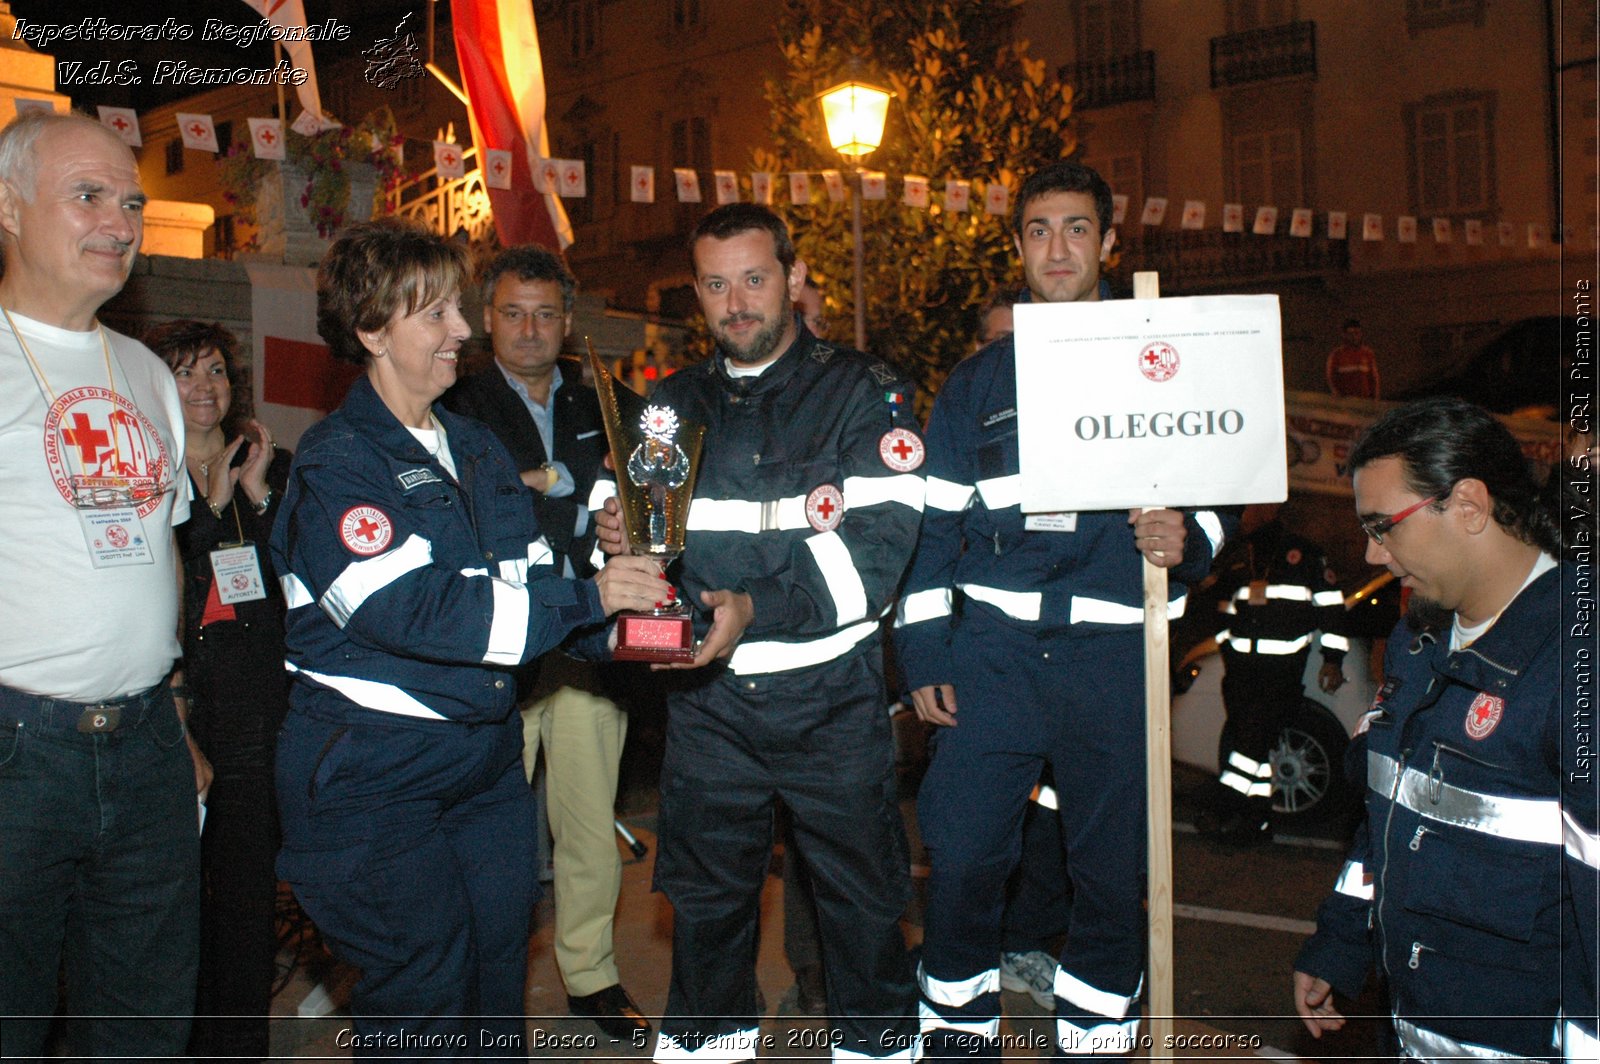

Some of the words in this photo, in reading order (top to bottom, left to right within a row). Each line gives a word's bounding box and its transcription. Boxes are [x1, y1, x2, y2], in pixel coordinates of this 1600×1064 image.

[88, 388, 99, 397] DI
[102, 391, 134, 411] PRIMO
[50, 389, 86, 431] REGIONALE
[1074, 408, 1245, 442] OLEGGIO
[48, 434, 59, 464] GARA
